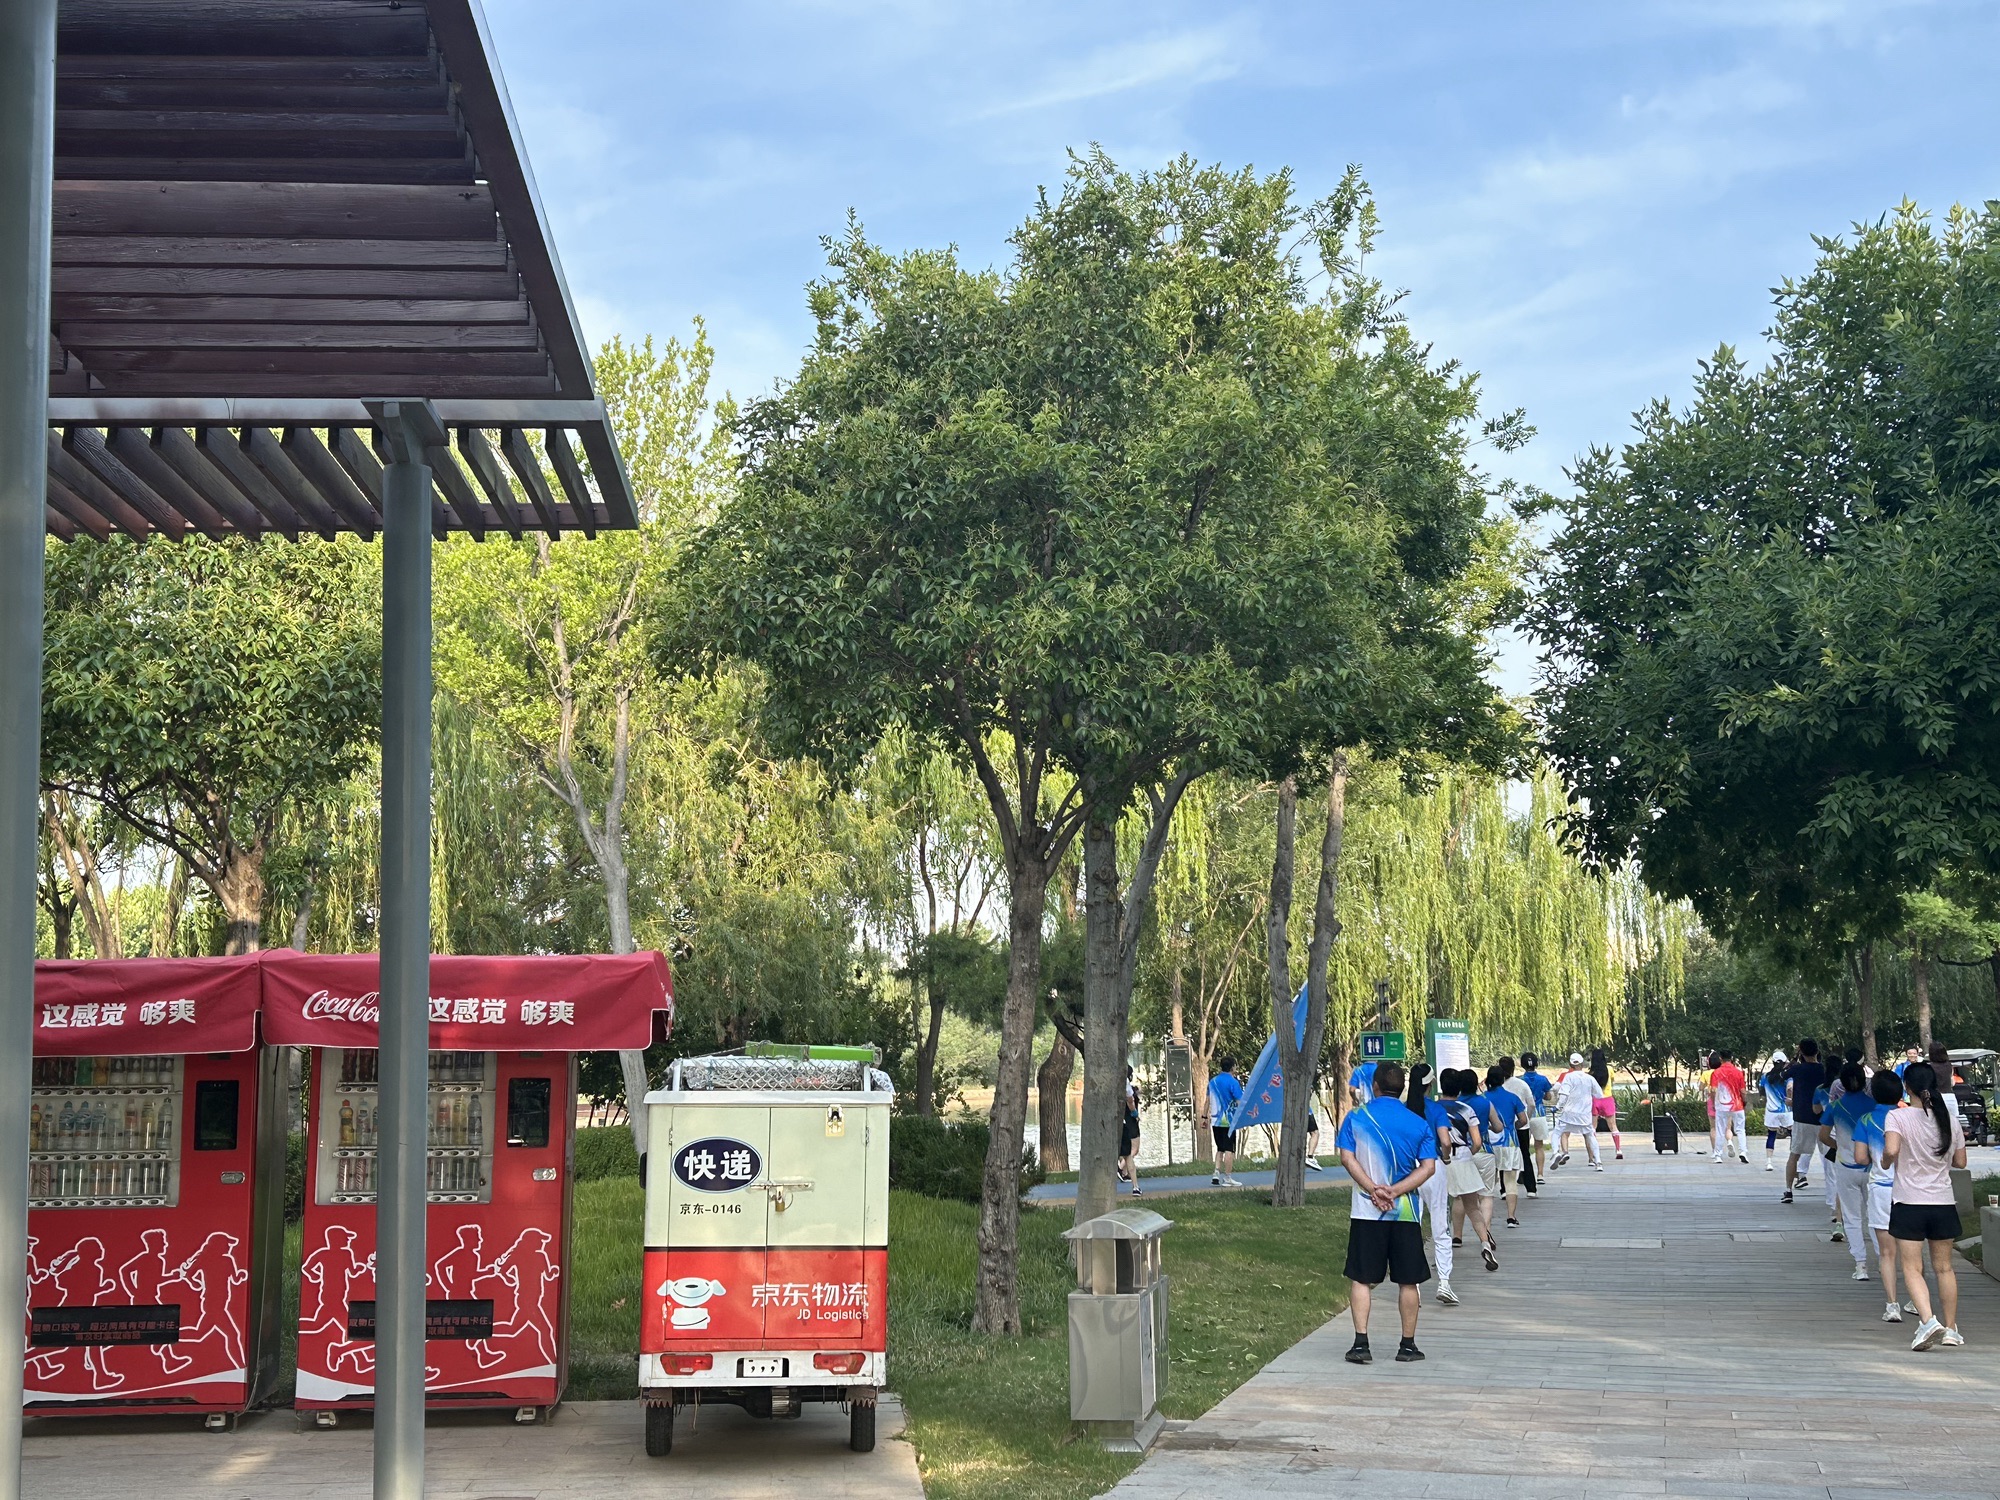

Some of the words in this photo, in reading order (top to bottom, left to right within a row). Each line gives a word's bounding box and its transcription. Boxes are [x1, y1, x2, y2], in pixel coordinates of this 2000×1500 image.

[40, 1003, 127, 1028] 这感觉
[139, 999, 196, 1025] 够爽
[302, 990, 380, 1022] Coca-Co
[429, 997, 506, 1024] 这感觉
[520, 1000, 575, 1025] 够爽
[683, 1149, 752, 1180] 快递
[680, 1203, 742, 1215] 京东-0146
[751, 1282, 869, 1307] 京东物流
[797, 1309, 811, 1320] JD
[816, 1309, 869, 1322] Logistics
